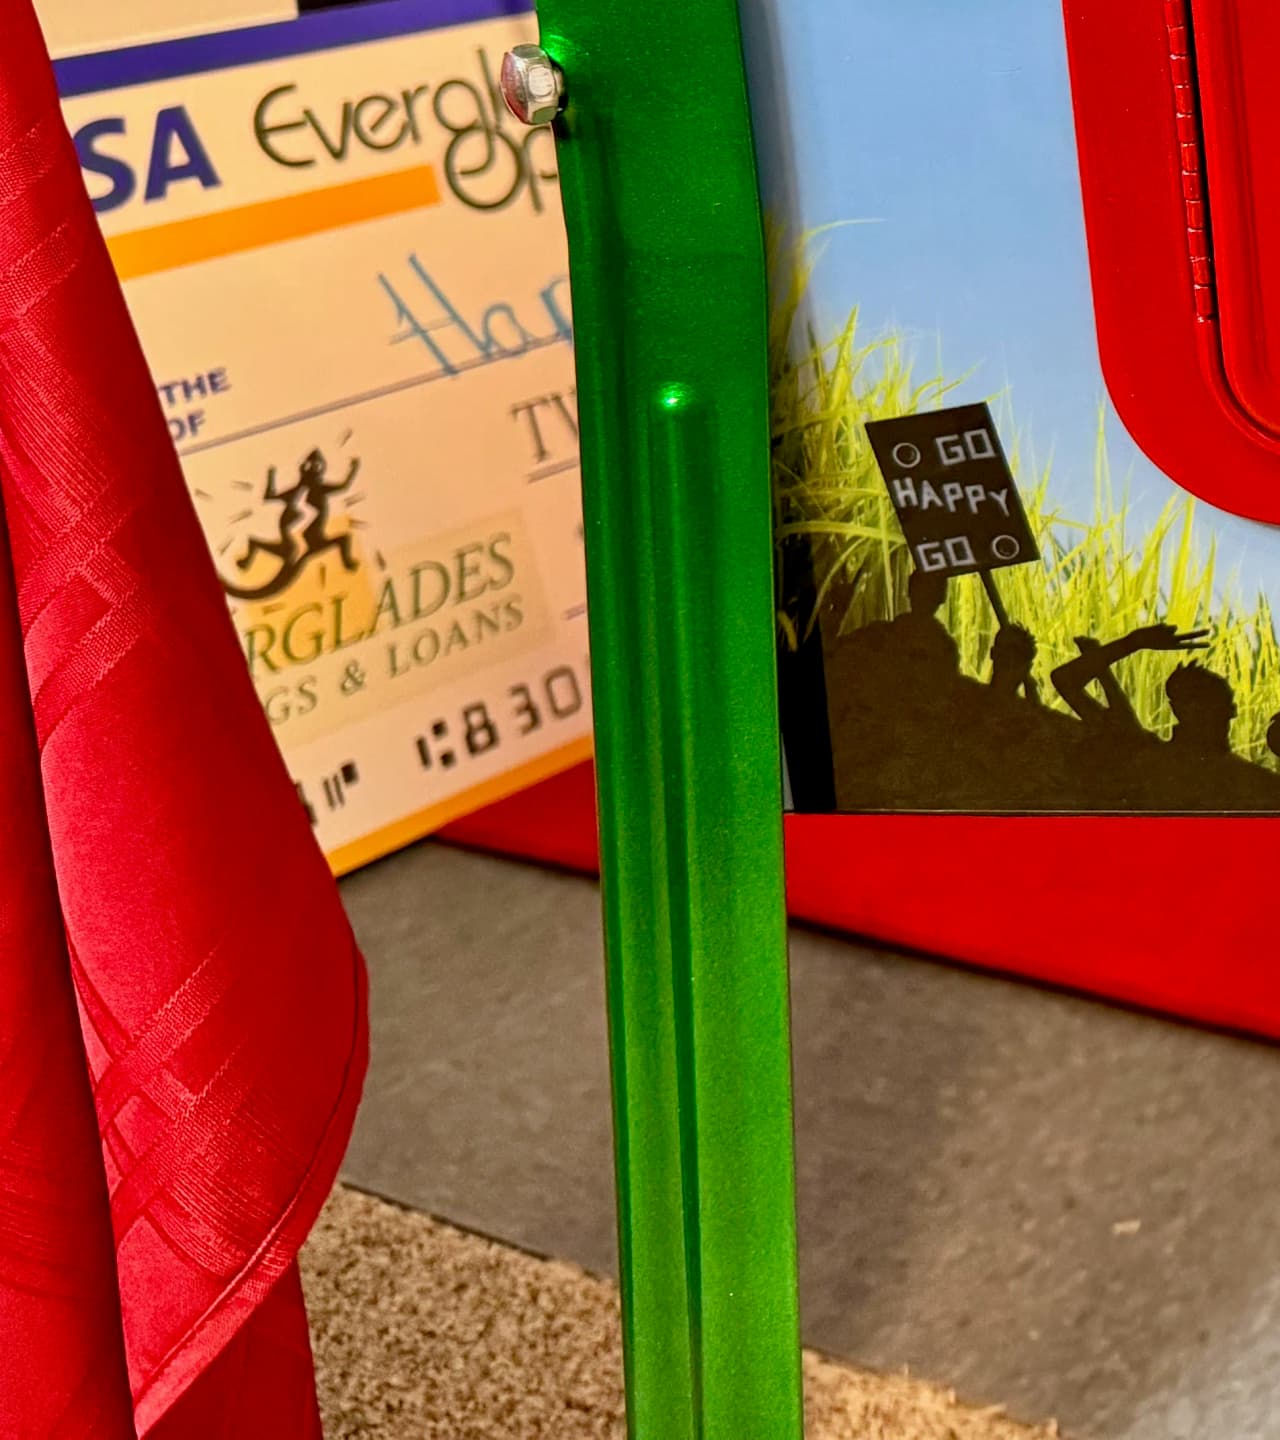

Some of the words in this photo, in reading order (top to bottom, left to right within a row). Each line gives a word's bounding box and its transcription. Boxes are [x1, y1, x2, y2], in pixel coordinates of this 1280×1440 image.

[935, 428, 996, 466] GO
[892, 477, 1010, 517] HAPPY
[916, 535, 977, 572] GO
[387, 594, 524, 678] LOANS
